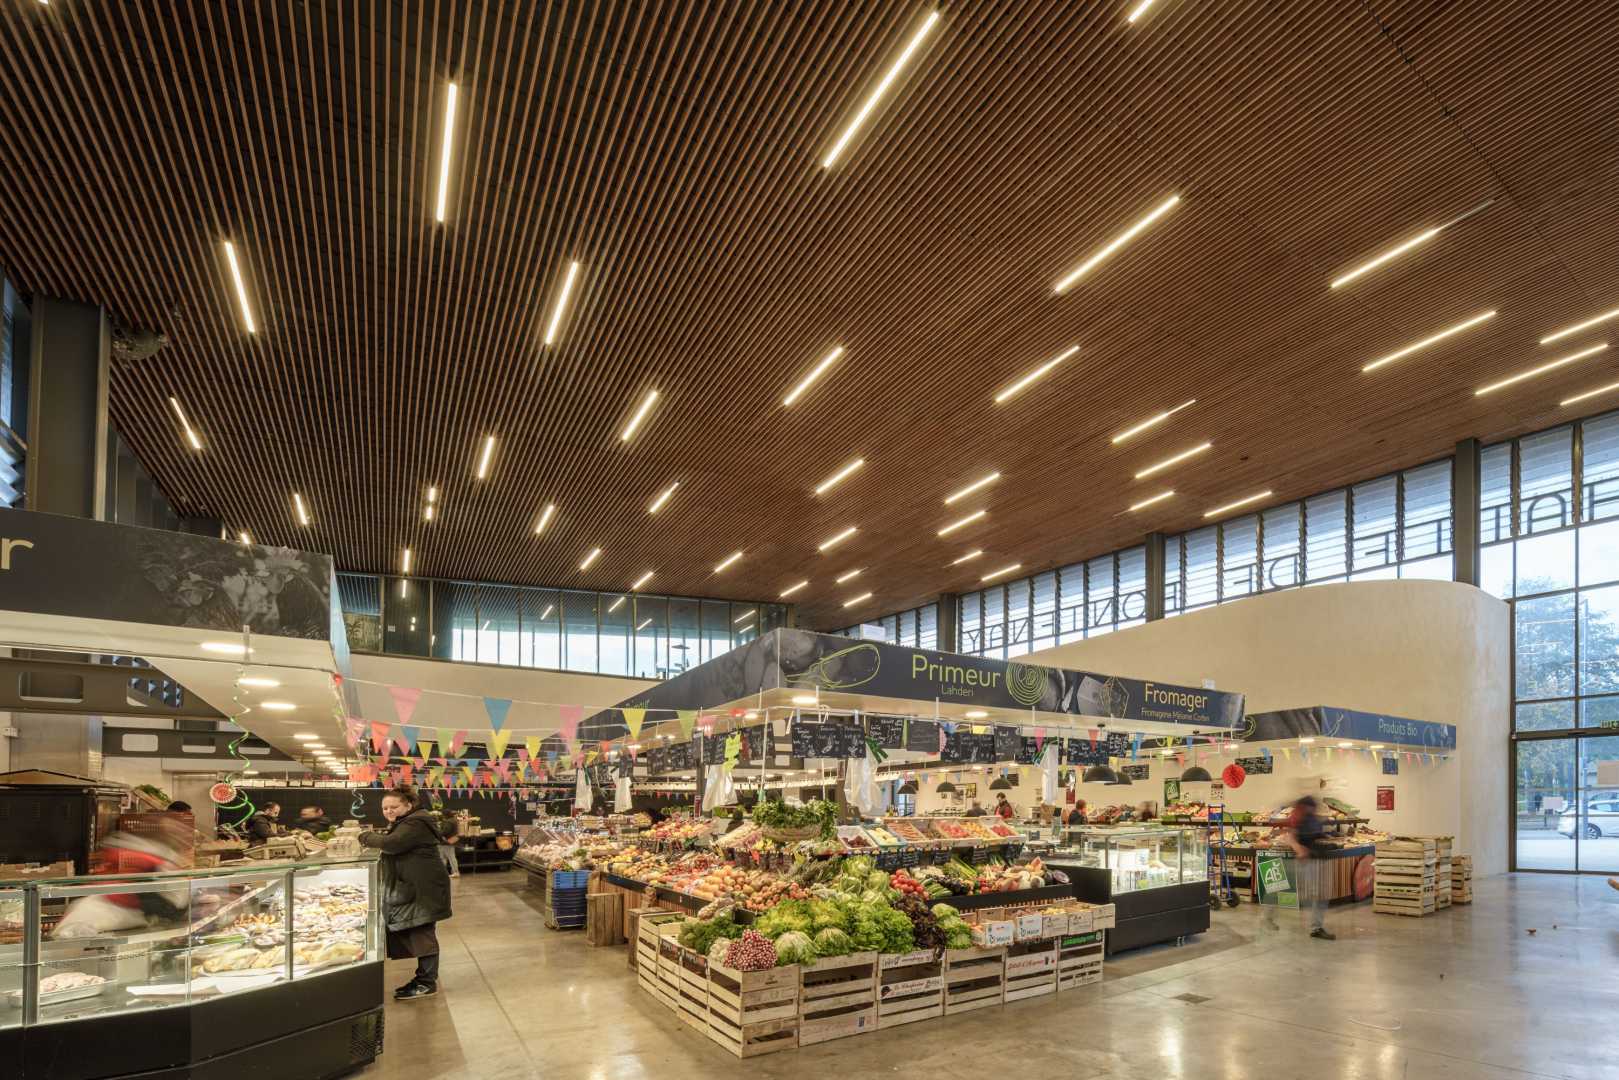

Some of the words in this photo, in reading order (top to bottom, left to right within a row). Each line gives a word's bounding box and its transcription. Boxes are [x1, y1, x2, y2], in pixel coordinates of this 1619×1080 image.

[912, 654, 1001, 688] Primeur
[1144, 682, 1208, 712] Fromager
[1378, 718, 1405, 736] Produits
[1406, 722, 1418, 737] Bio
